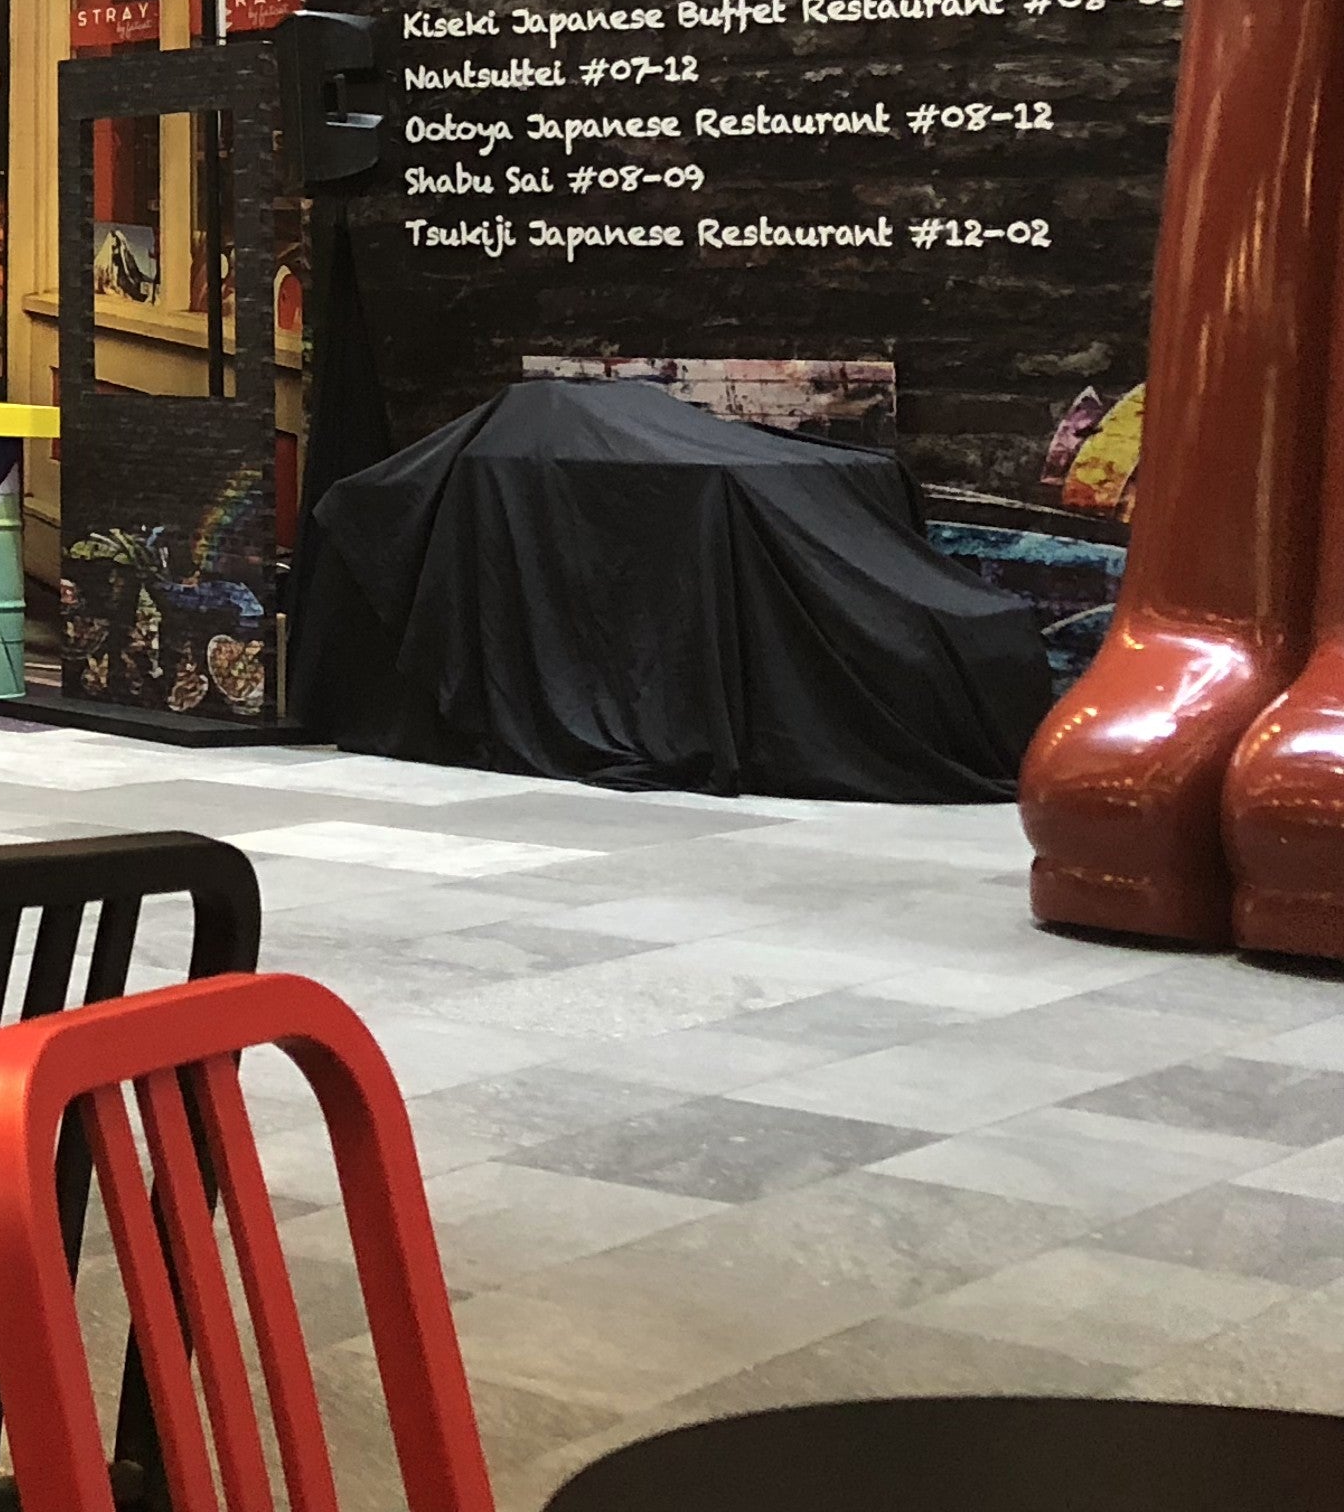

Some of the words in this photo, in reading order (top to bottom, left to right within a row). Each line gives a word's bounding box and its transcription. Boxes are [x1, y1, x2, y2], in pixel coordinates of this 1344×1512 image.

[77, 2, 150, 28] STRAY
[403, 9, 500, 39] Kiseki
[512, 7, 665, 49] Japanese
[406, 58, 565, 90] Nantsuttei
[579, 55, 700, 87] #07-12
[405, 113, 513, 157] Ootoya
[526, 113, 682, 156] Japanese
[695, 102, 891, 139] Restaurant
[906, 101, 1055, 135] #08-12
[405, 161, 495, 195] Shabu
[505, 166, 554, 195] Sai
[567, 164, 705, 195] #08-09
[405, 214, 517, 258] Tsukiji
[528, 218, 685, 263] Japanese
[697, 216, 894, 249] Restaurant
[908, 218, 1054, 251] #12-02
